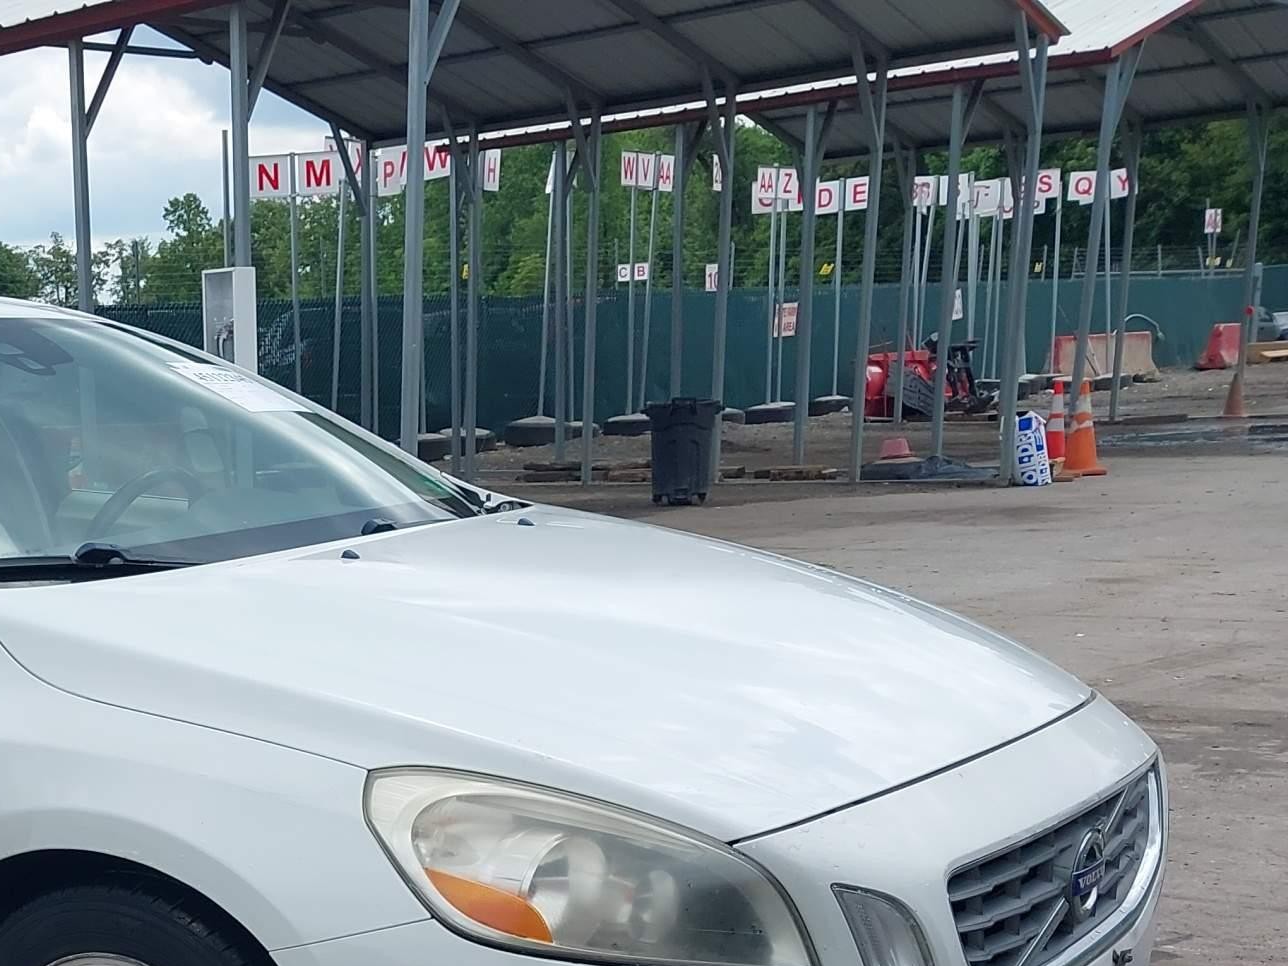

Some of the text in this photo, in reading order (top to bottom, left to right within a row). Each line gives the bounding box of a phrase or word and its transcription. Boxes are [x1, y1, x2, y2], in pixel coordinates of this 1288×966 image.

[257, 162, 280, 191] N
[305, 159, 331, 188] M
[383, 160, 395, 188] P
[487, 157, 497, 184] H
[623, 156, 635, 181] W
[642, 158, 650, 182] V
[759, 171, 774, 194] AA
[782, 172, 793, 194] Z
[852, 182, 867, 204] E
[1038, 174, 1052, 193] S
[1074, 176, 1093, 196] Q
[1117, 175, 1130, 192] Y
[817, 187, 833, 209] D
[618, 266, 628, 278] C
[637, 264, 646, 277] B
